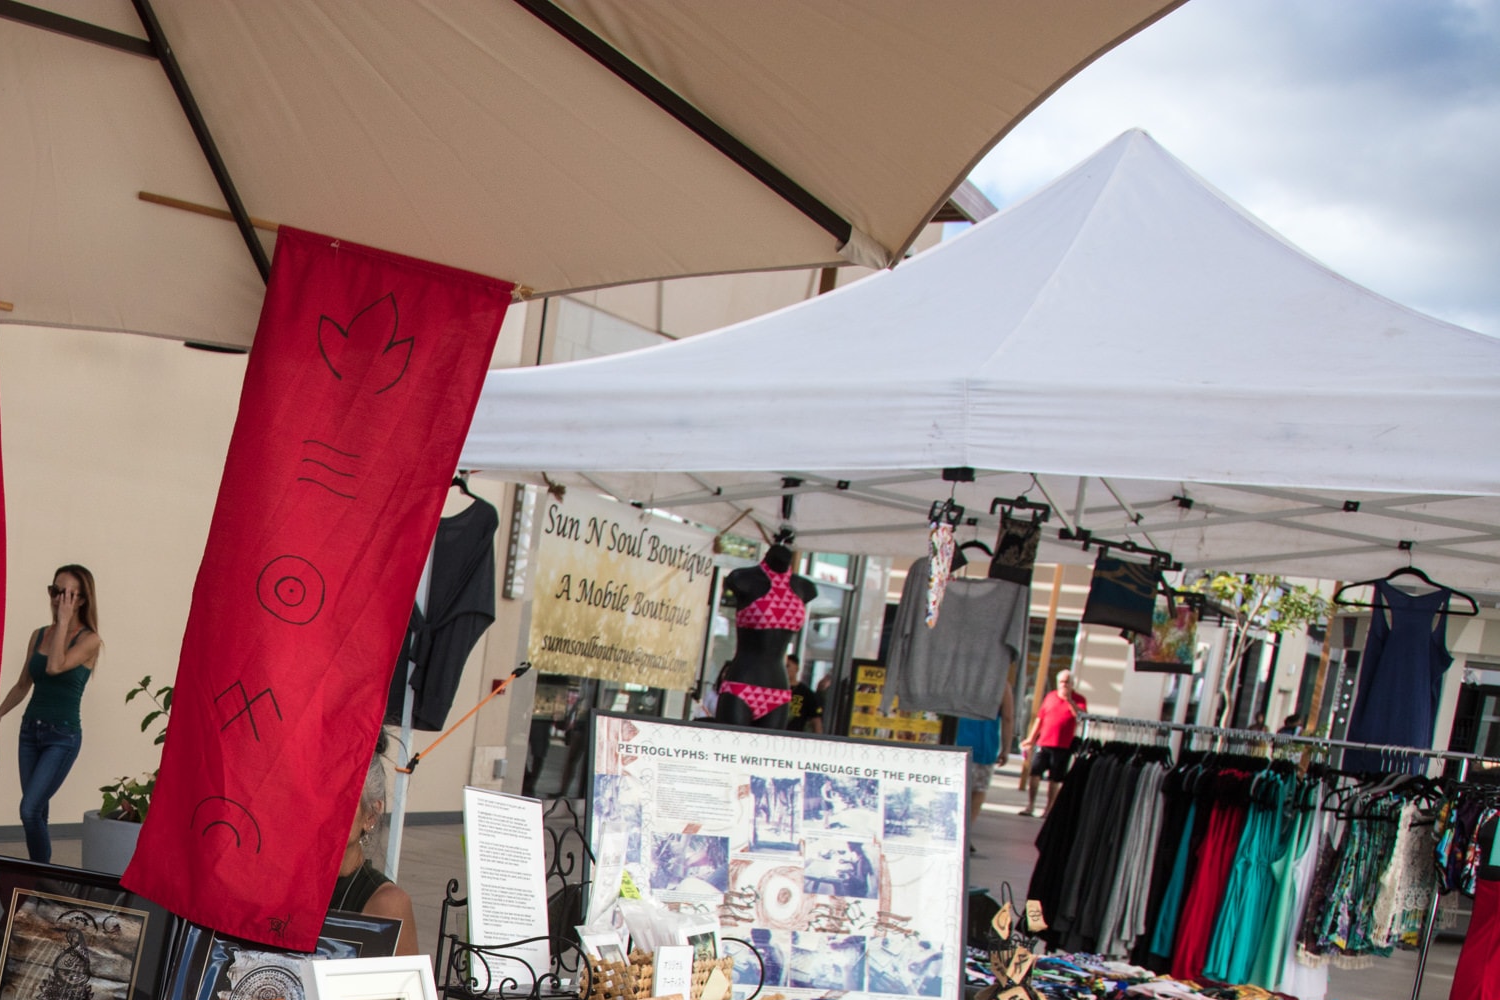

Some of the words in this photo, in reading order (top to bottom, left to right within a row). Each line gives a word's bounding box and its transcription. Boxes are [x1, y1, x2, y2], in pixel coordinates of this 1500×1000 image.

[545, 504, 581, 542] Sun
[585, 517, 608, 547] N
[607, 523, 648, 559] Soul
[647, 535, 713, 582] Boutique
[555, 574, 573, 602] A
[575, 578, 630, 613] Mobile
[632, 592, 691, 633] Boutique
[618, 743, 708, 761] PETROGLYPHS:
[714, 752, 737, 763] THE
[740, 755, 793, 769] WRITTEN
[798, 761, 861, 776] LANGUAGE
[864, 768, 879, 778] OF
[883, 770, 905, 781] THE
[908, 773, 951, 786] PEOPLE
